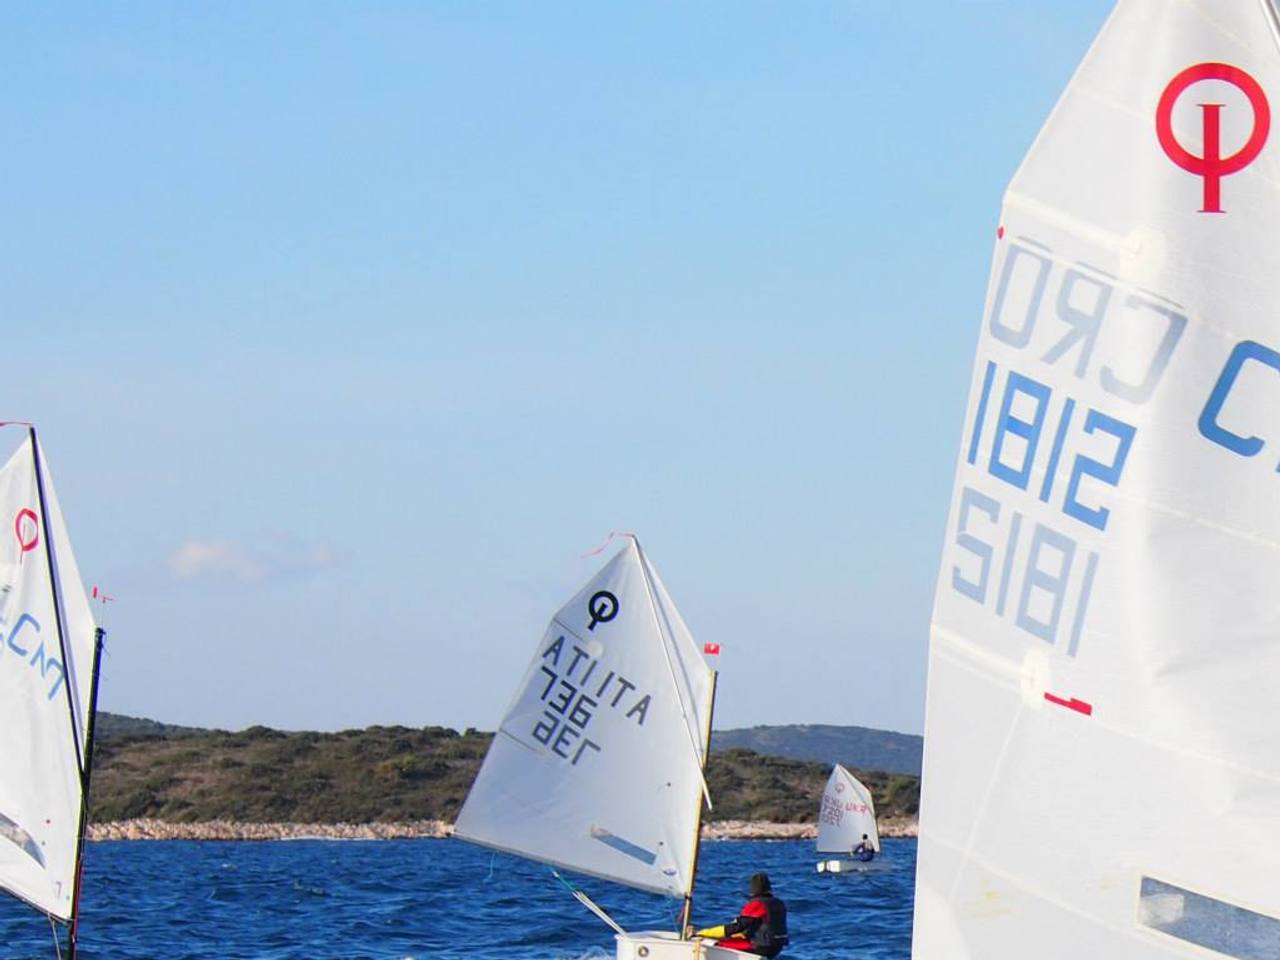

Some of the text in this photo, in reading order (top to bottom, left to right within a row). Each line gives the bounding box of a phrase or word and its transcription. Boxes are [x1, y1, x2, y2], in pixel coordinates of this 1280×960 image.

[967, 360, 1137, 532] 1812
[541, 664, 598, 730] 736
[596, 670, 651, 726] ITA
